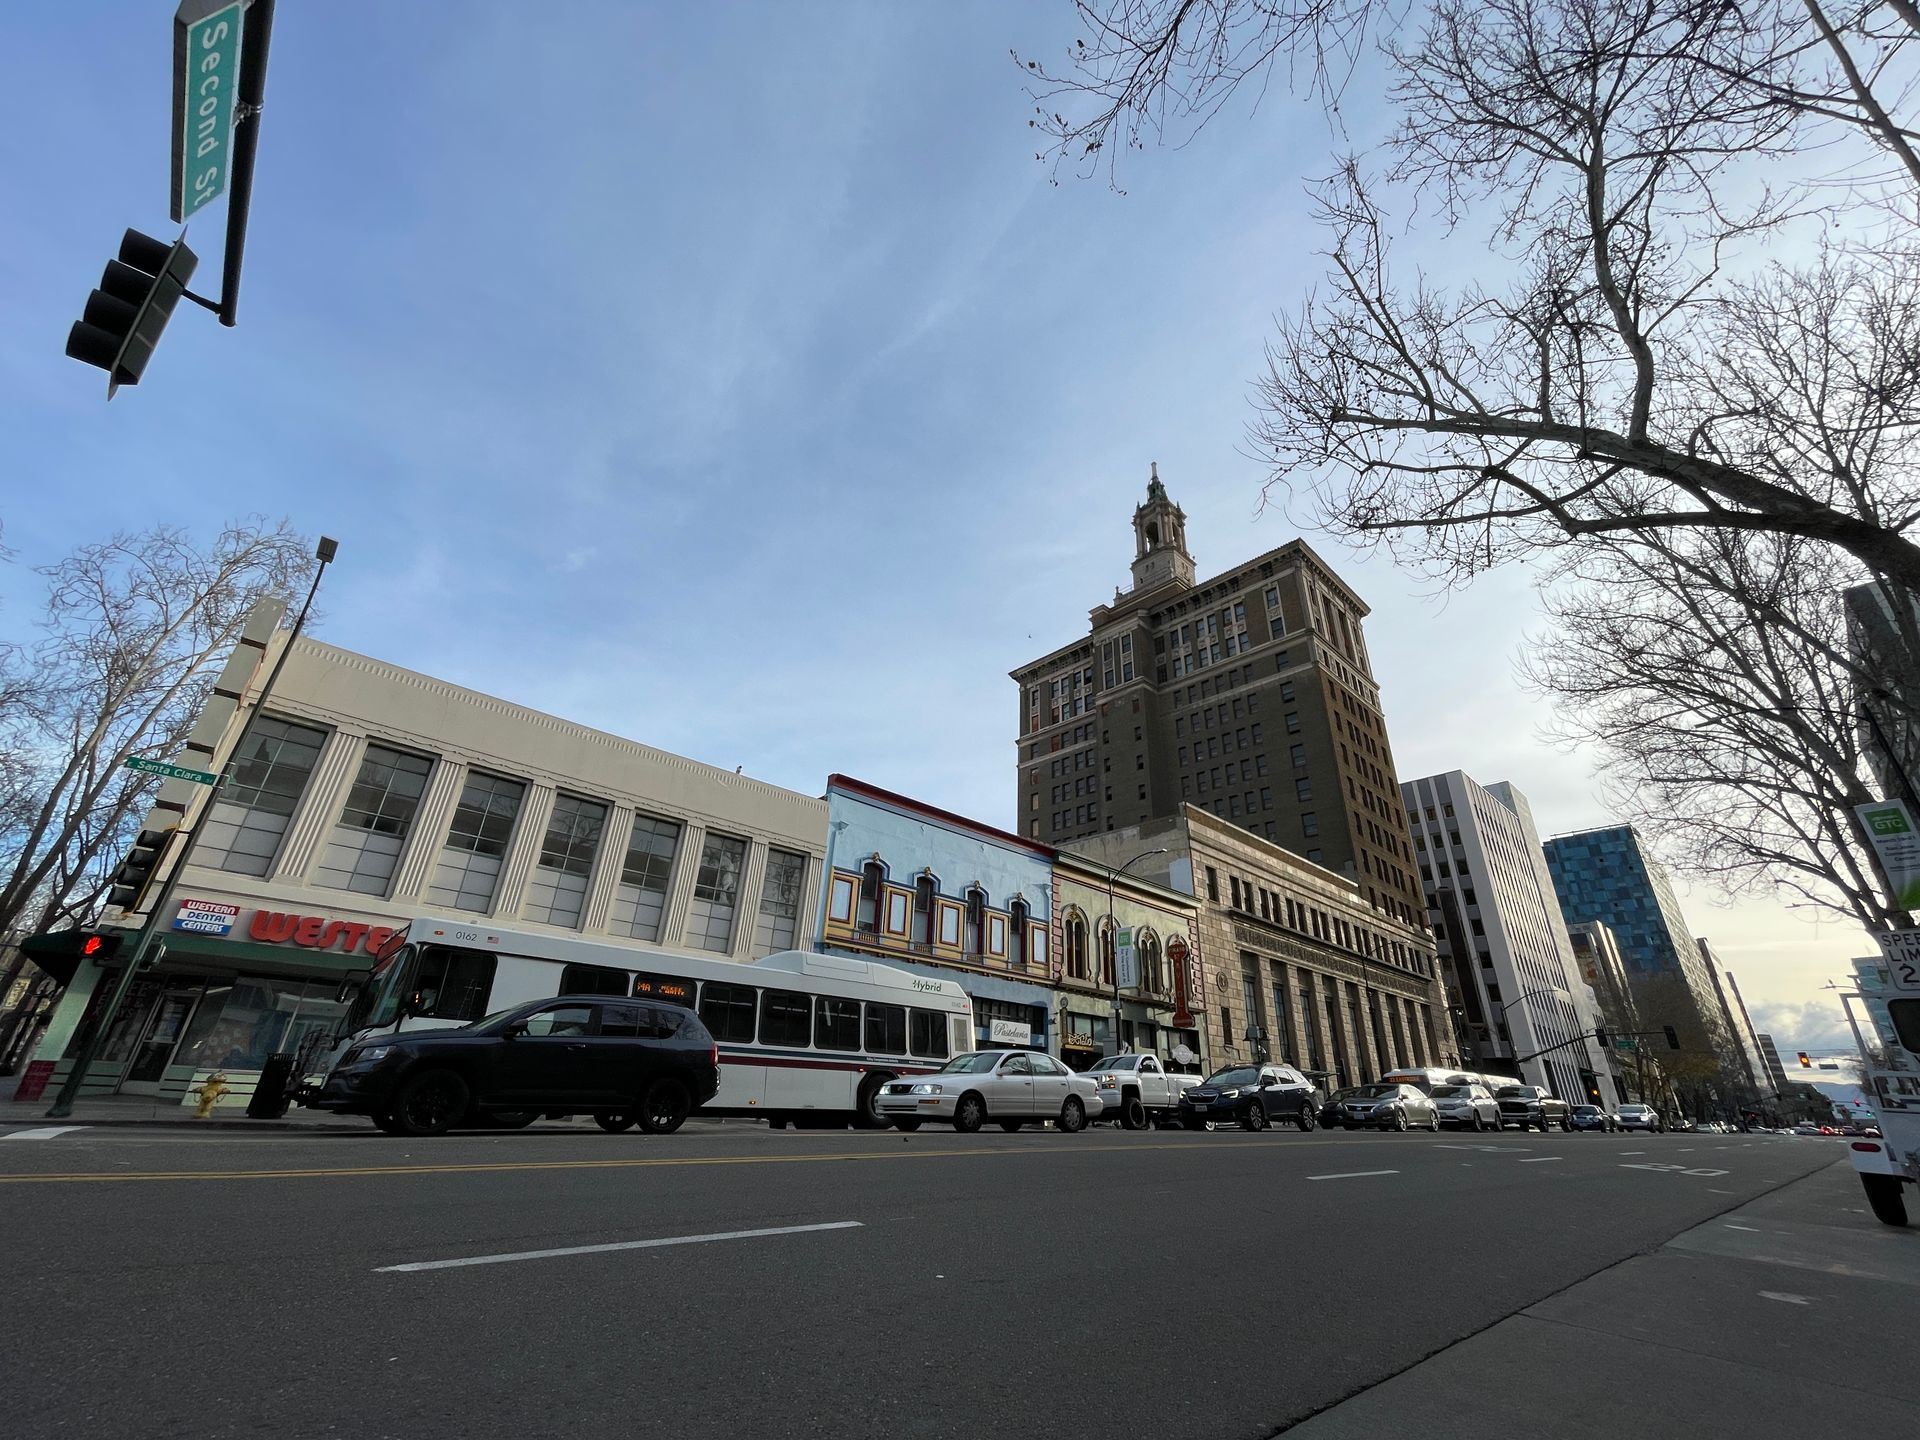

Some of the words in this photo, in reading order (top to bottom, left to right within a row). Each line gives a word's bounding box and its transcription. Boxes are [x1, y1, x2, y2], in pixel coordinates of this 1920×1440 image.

[197, 21, 229, 158] Second
[194, 166, 218, 206] St
[137, 761, 171, 774] Santa
[174, 768, 202, 781] Clara
[1874, 818, 1904, 830] GTC
[187, 901, 236, 914] WESTERN
[187, 911, 227, 923] DENTAL
[181, 920, 225, 933] CENTERS
[455, 931, 478, 942] 0162
[913, 980, 942, 992] Hybrid
